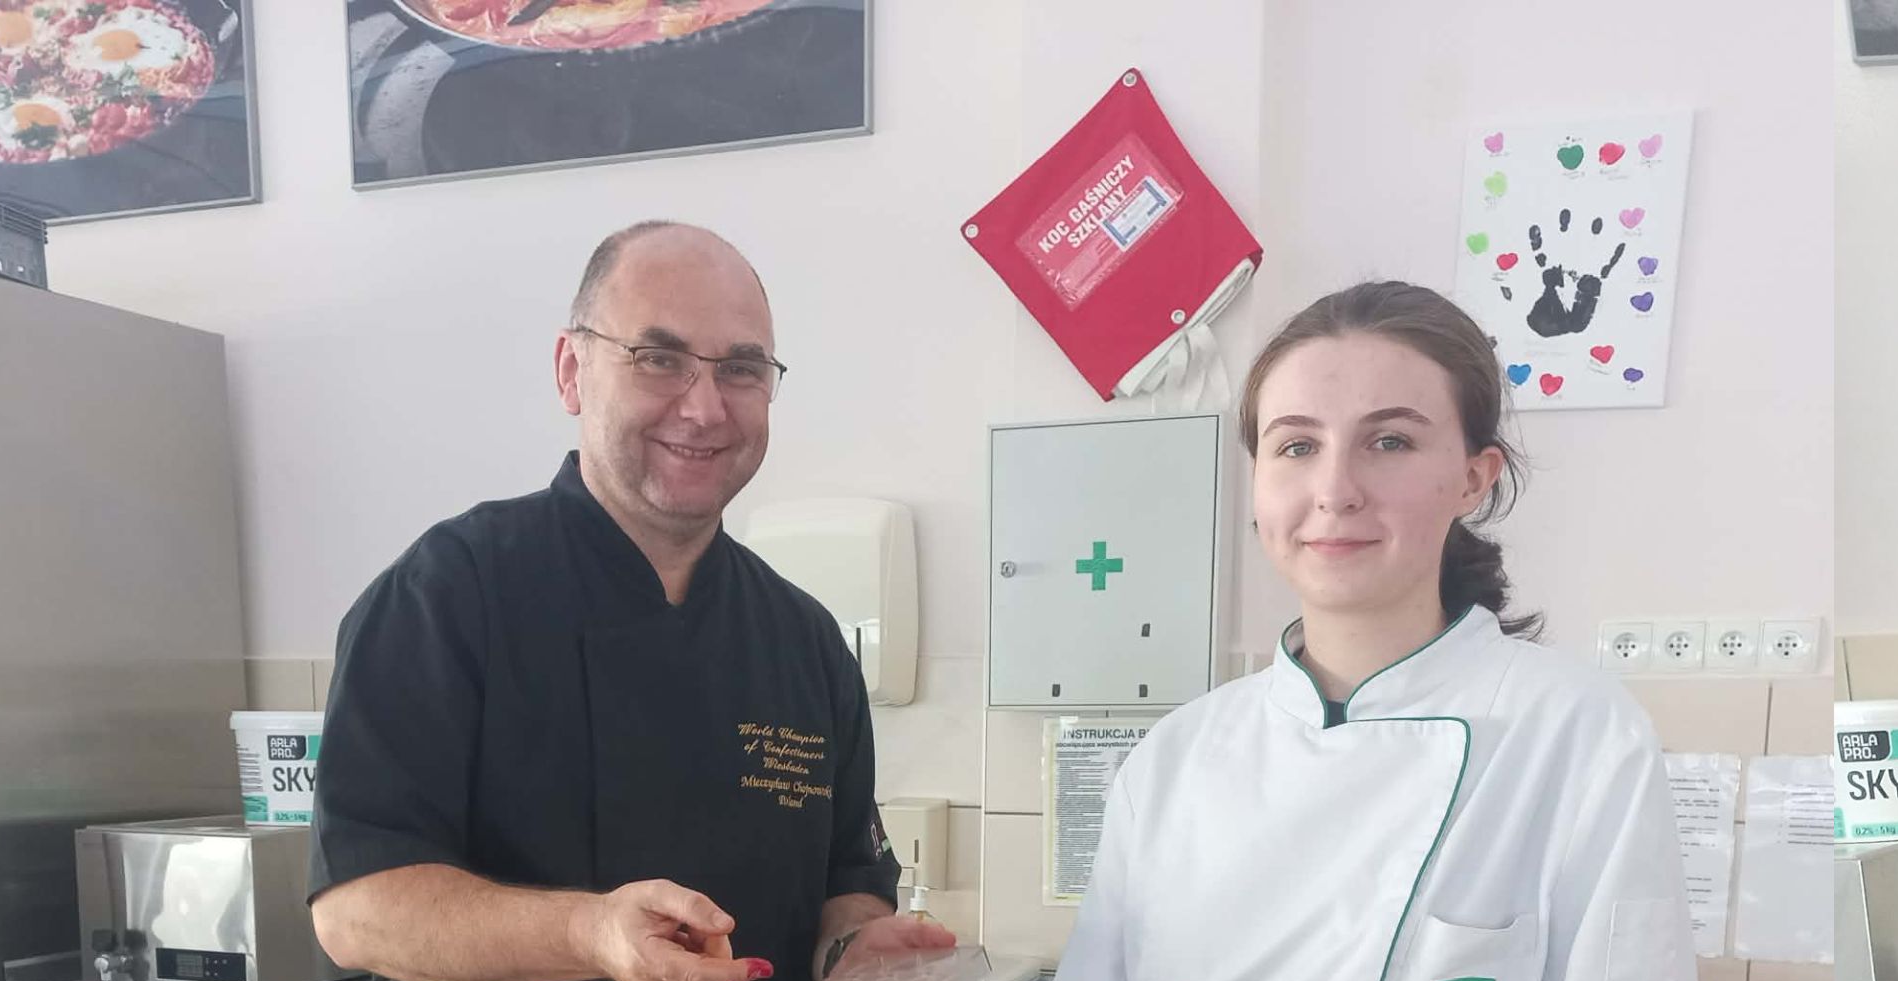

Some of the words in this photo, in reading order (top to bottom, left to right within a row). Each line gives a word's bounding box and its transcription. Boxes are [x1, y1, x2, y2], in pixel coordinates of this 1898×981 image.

[1038, 221, 1070, 253] KOC
[1068, 155, 1134, 223] GAŚNICZY
[738, 723, 774, 737] World
[1063, 728, 1135, 739] INSTRUKCJA
[270, 737, 297, 748] ARLA
[744, 739, 759, 755] of
[1842, 734, 1878, 747] ARLA
